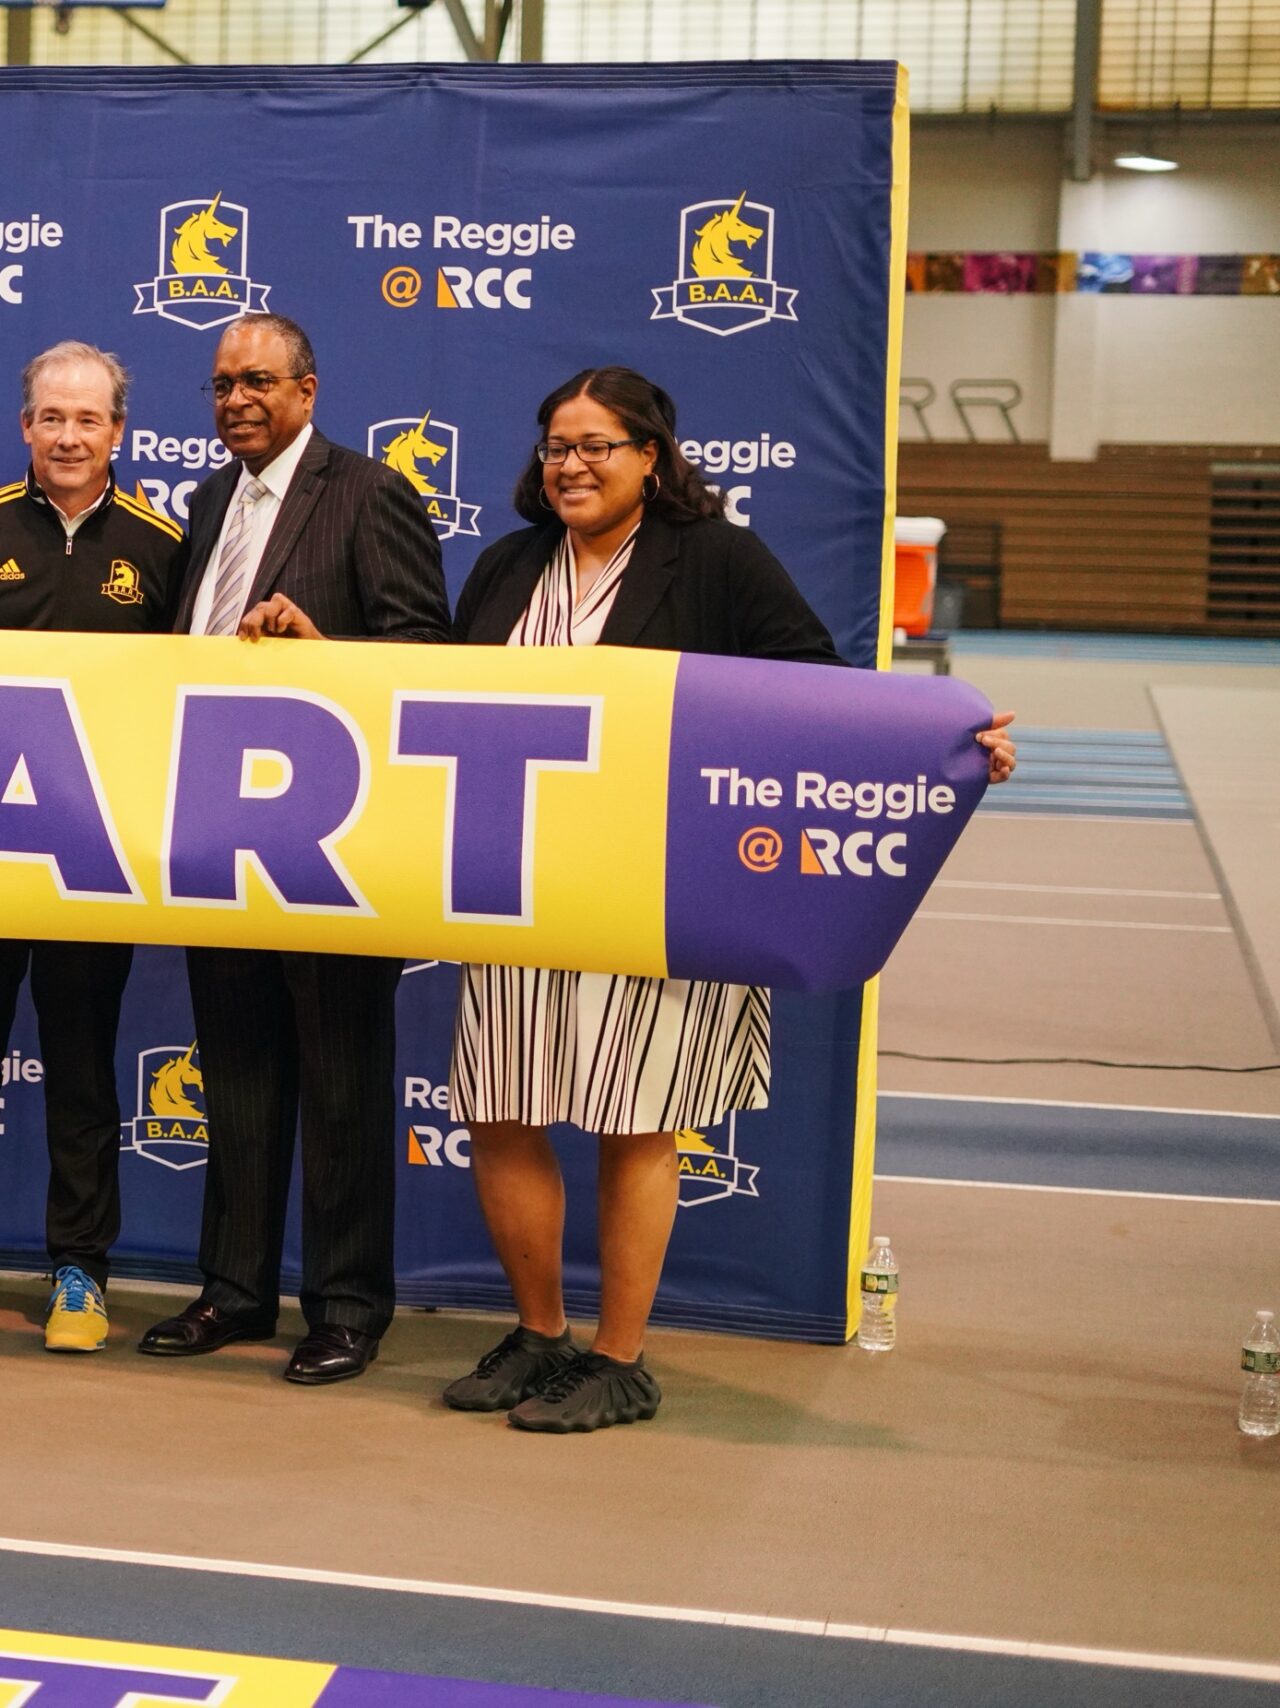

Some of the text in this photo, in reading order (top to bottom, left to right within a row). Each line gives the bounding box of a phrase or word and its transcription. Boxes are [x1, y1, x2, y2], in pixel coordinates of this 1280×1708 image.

[347, 214, 576, 256] The Reggie
[168, 279, 240, 299] B.A.A.
[381, 266, 532, 309] @ RCC
[688, 283, 764, 304] B.A.A.
[131, 429, 233, 469] Regg
[674, 432, 797, 474] eggie
[700, 768, 956, 820] The Reggie
[738, 826, 907, 877] @ RCC
